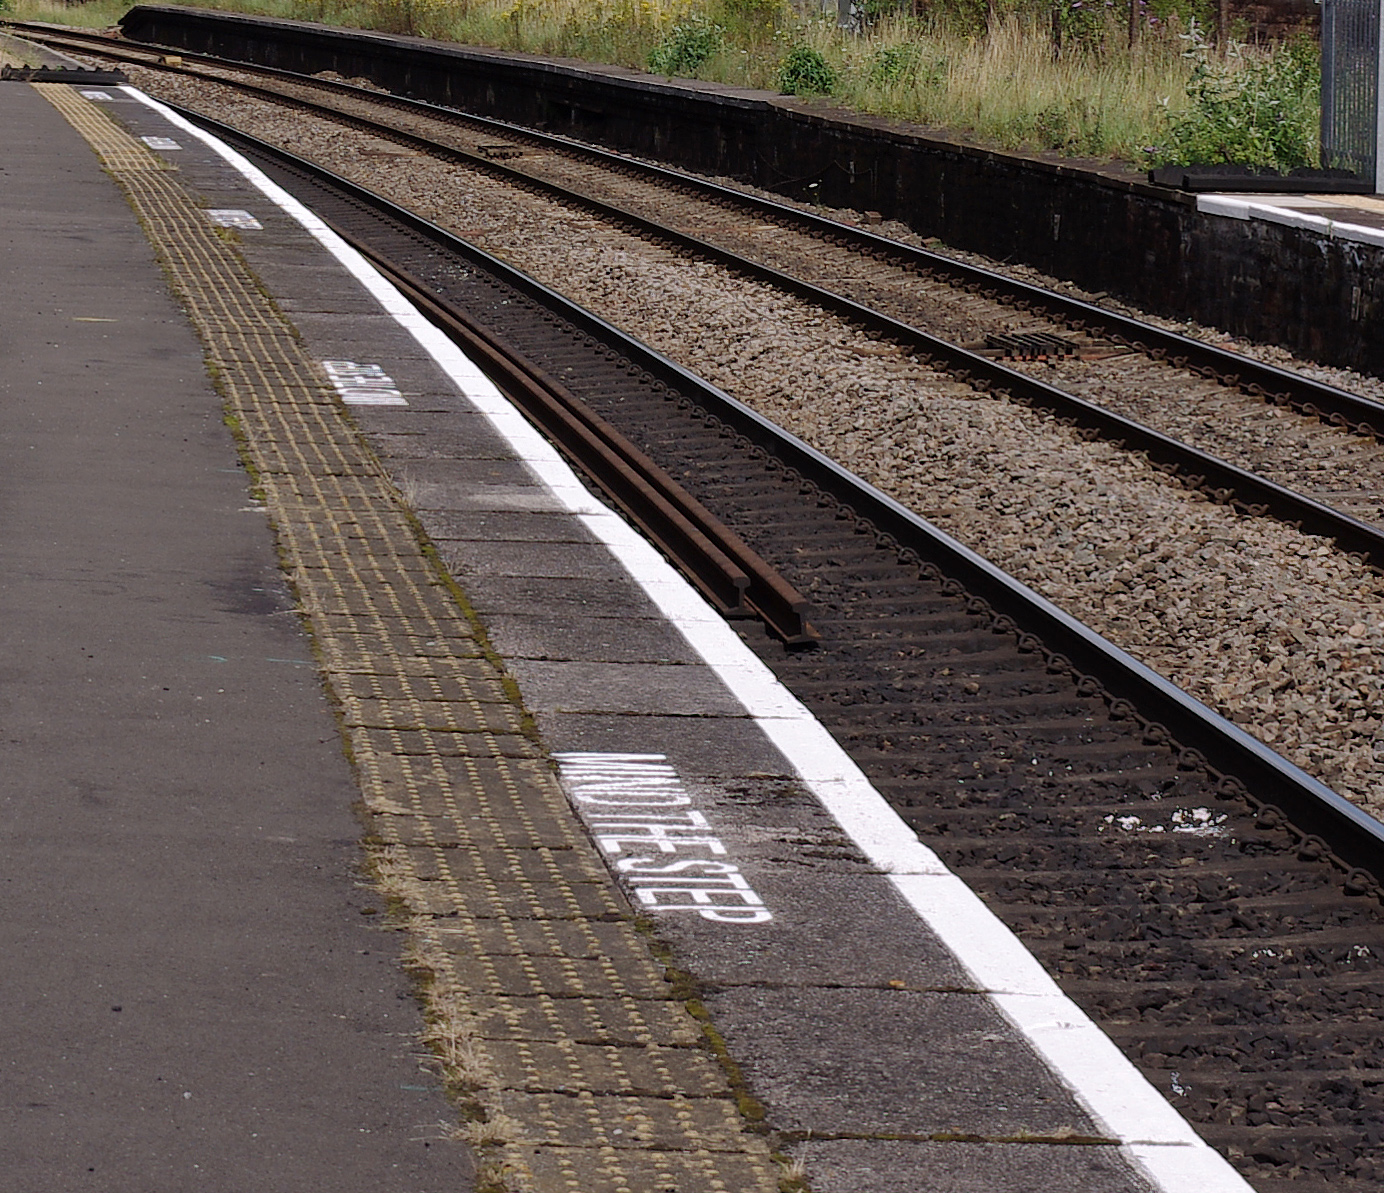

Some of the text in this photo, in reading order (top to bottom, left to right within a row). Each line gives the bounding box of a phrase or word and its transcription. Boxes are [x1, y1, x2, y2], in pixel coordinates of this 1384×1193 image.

[549, 752, 774, 923] MIND THE STEP
